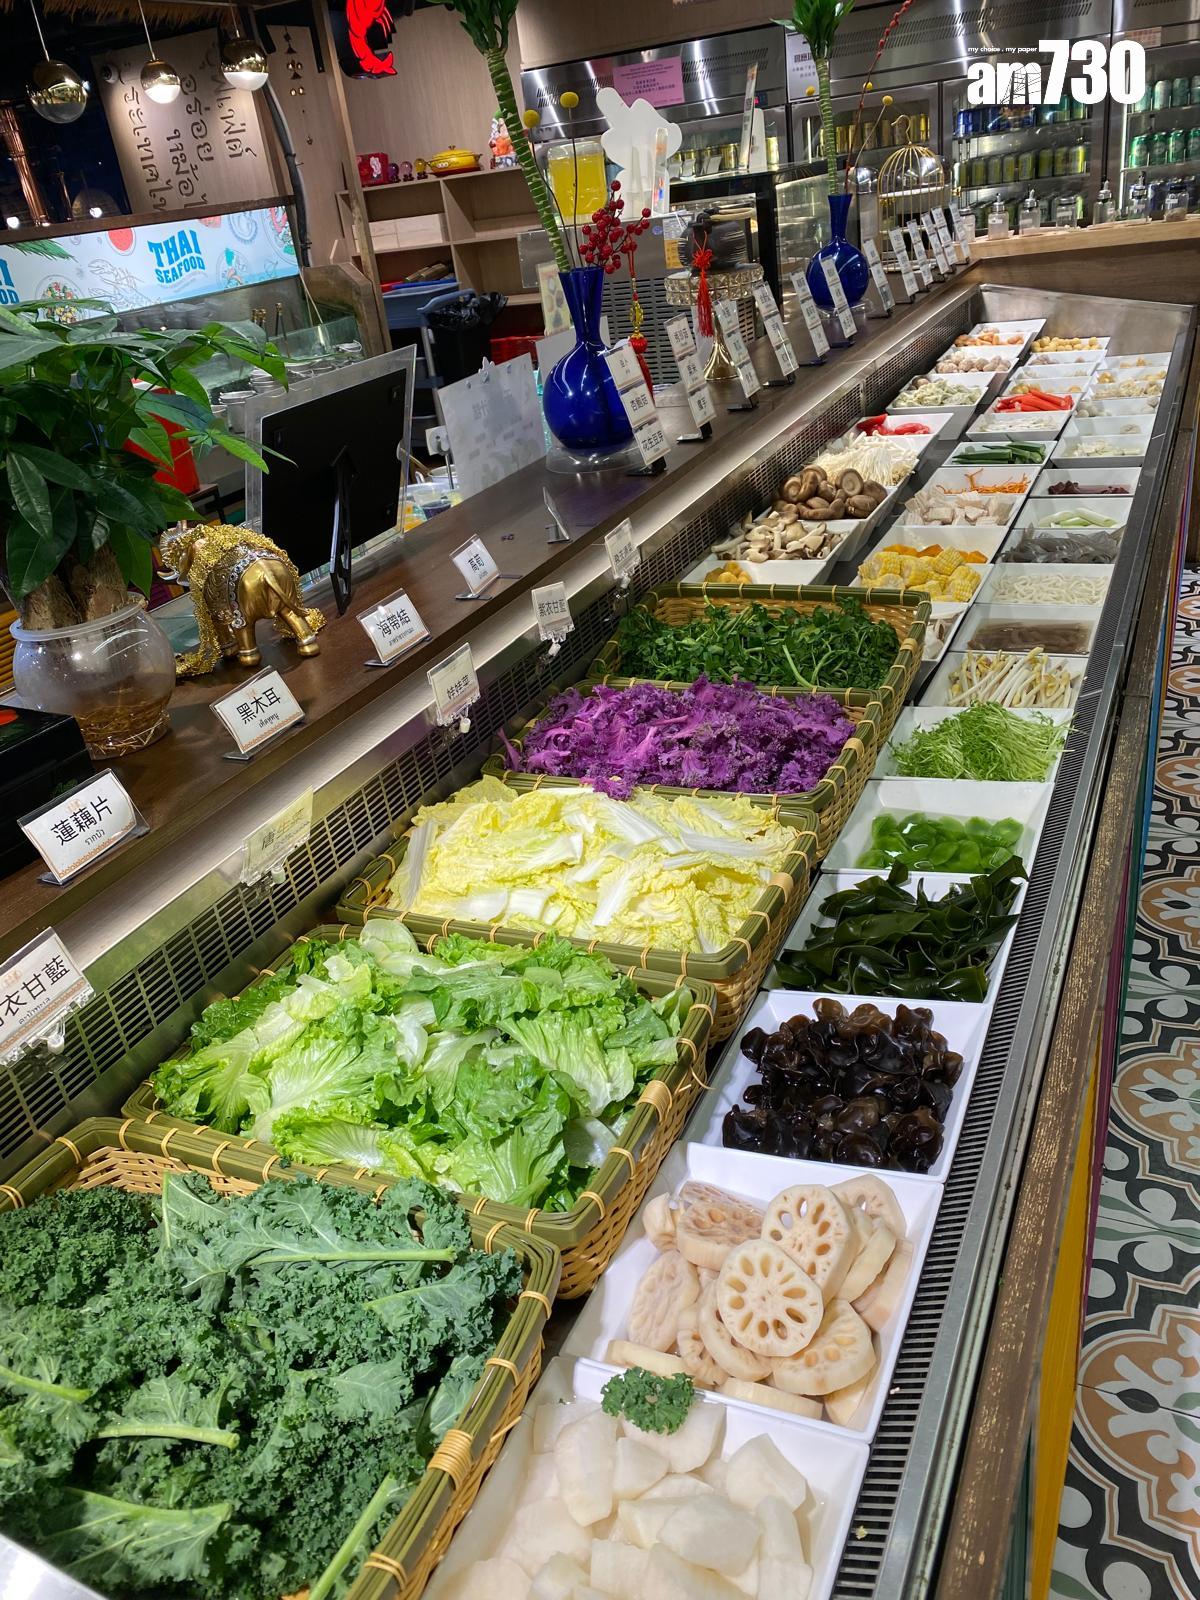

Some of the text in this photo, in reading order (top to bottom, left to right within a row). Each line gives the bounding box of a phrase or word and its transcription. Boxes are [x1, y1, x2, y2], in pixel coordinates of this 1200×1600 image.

[147, 229, 202, 269] THAI
[154, 255, 206, 285] SEAFOOD
[630, 394, 649, 412] 杏鮑菇
[377, 607, 412, 638] 海帶結
[235, 686, 282, 726] 黑木耳
[50, 794, 113, 847] 蓮藕片
[0, 955, 71, 1030] 衣甘藍
